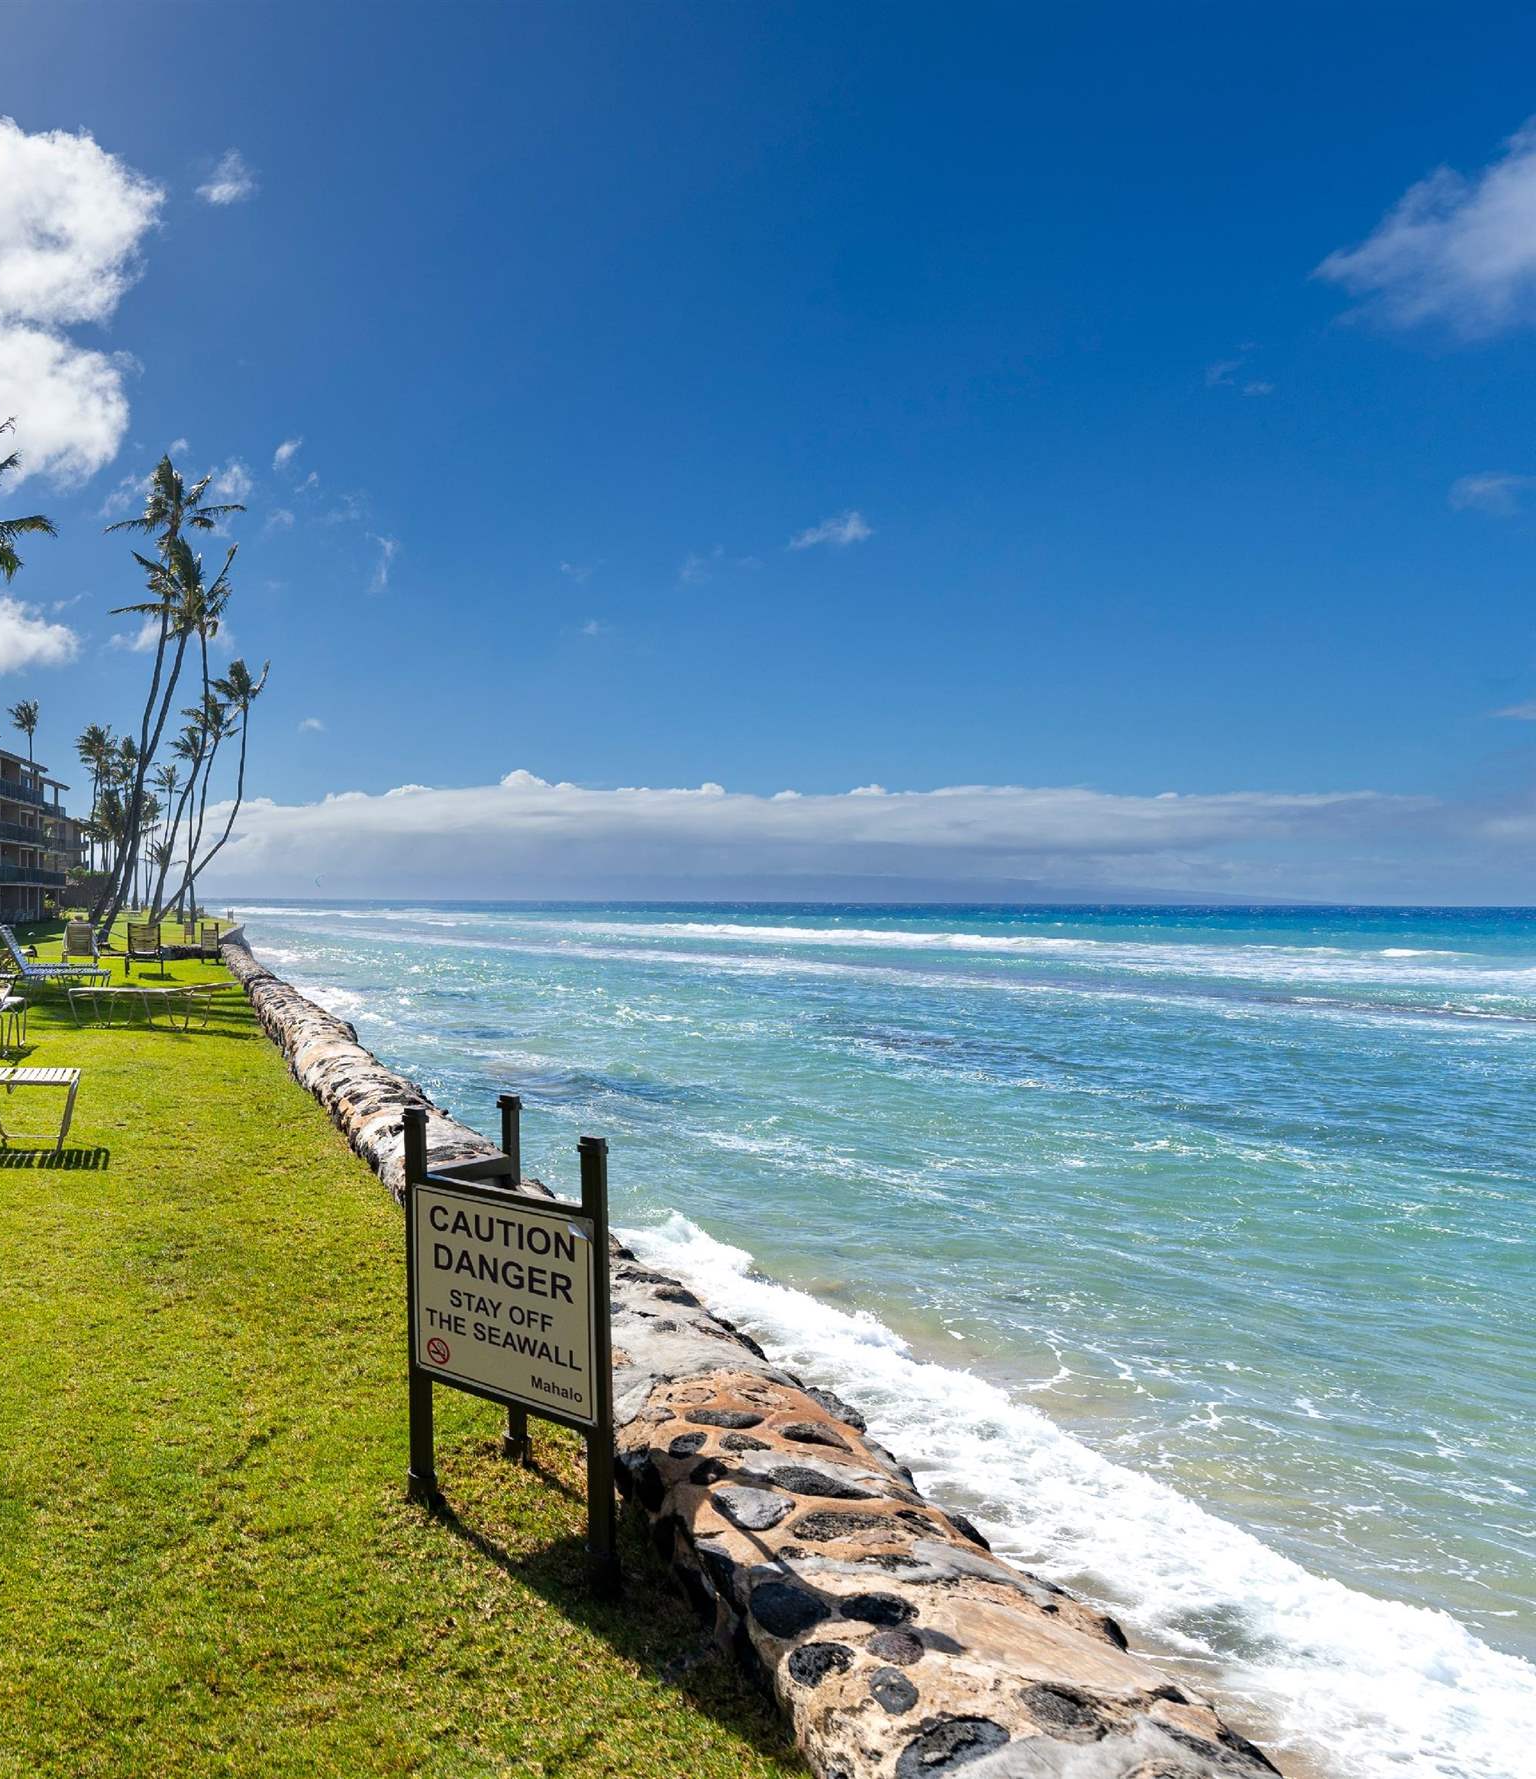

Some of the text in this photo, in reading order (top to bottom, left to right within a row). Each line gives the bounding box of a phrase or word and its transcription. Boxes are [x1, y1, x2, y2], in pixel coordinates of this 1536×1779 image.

[430, 1205, 575, 1262] CAUTION
[434, 1243, 574, 1304] DANGER
[450, 1289, 553, 1332] STAY OFF
[426, 1308, 582, 1371] THE SEAWALL
[531, 1375, 583, 1403] Mahalo
